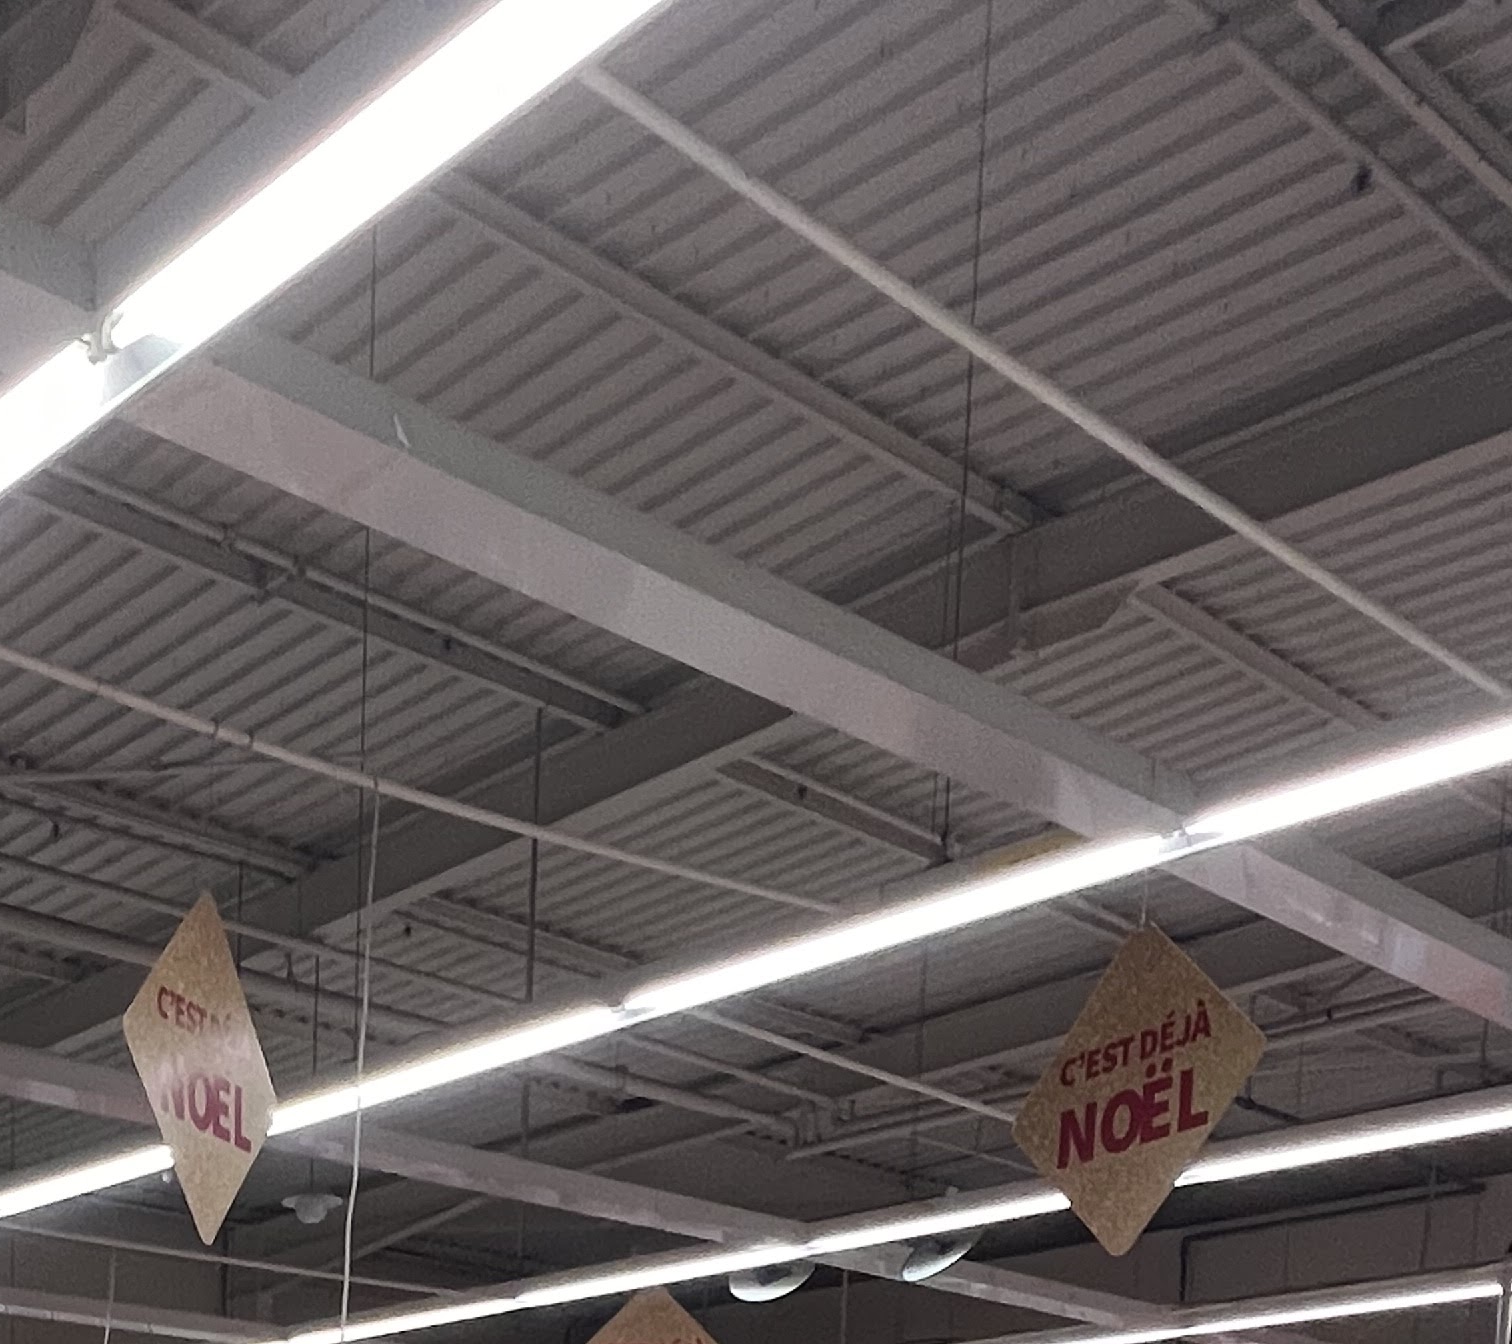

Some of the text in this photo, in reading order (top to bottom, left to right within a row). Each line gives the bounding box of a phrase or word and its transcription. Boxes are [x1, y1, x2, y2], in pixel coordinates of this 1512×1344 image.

[1060, 999, 1212, 1087] C'EST DÉJÀ
[1056, 1057, 1209, 1170] NOËL
